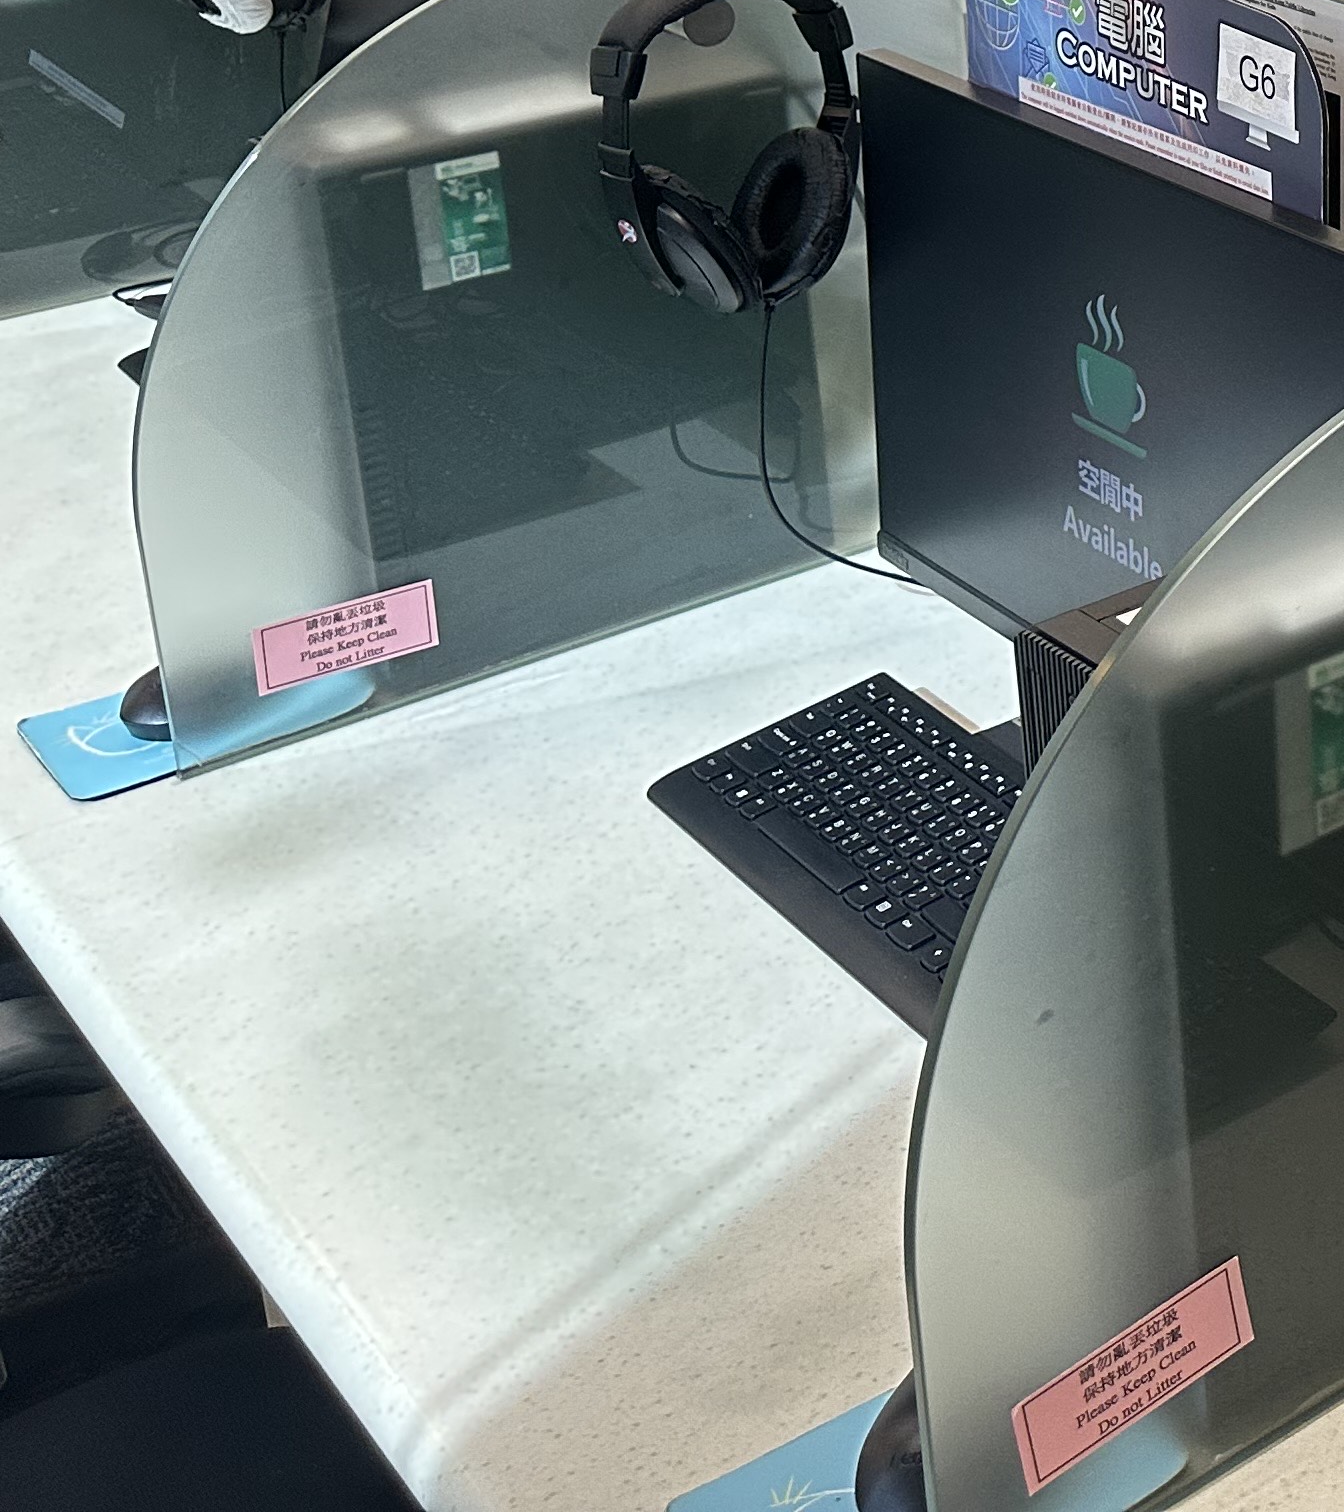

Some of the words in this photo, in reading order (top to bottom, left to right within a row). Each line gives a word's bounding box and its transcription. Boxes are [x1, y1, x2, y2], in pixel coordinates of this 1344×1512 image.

[1055, 30, 1209, 125] COMPUTER
[1239, 54, 1276, 100] G6
[1062, 504, 1164, 582] Available
[300, 646, 334, 662] Please
[337, 637, 365, 653] Keep
[367, 627, 398, 643] Clean
[316, 660, 333, 673] Do
[336, 654, 354, 667] not
[355, 645, 386, 662] Litter
[1076, 1395, 1119, 1430] Please
[1122, 1367, 1157, 1399] Keep
[1159, 1339, 1198, 1371] Clean
[1098, 1413, 1119, 1437] Do
[1122, 1397, 1144, 1421] not
[1145, 1369, 1184, 1405] Litter
